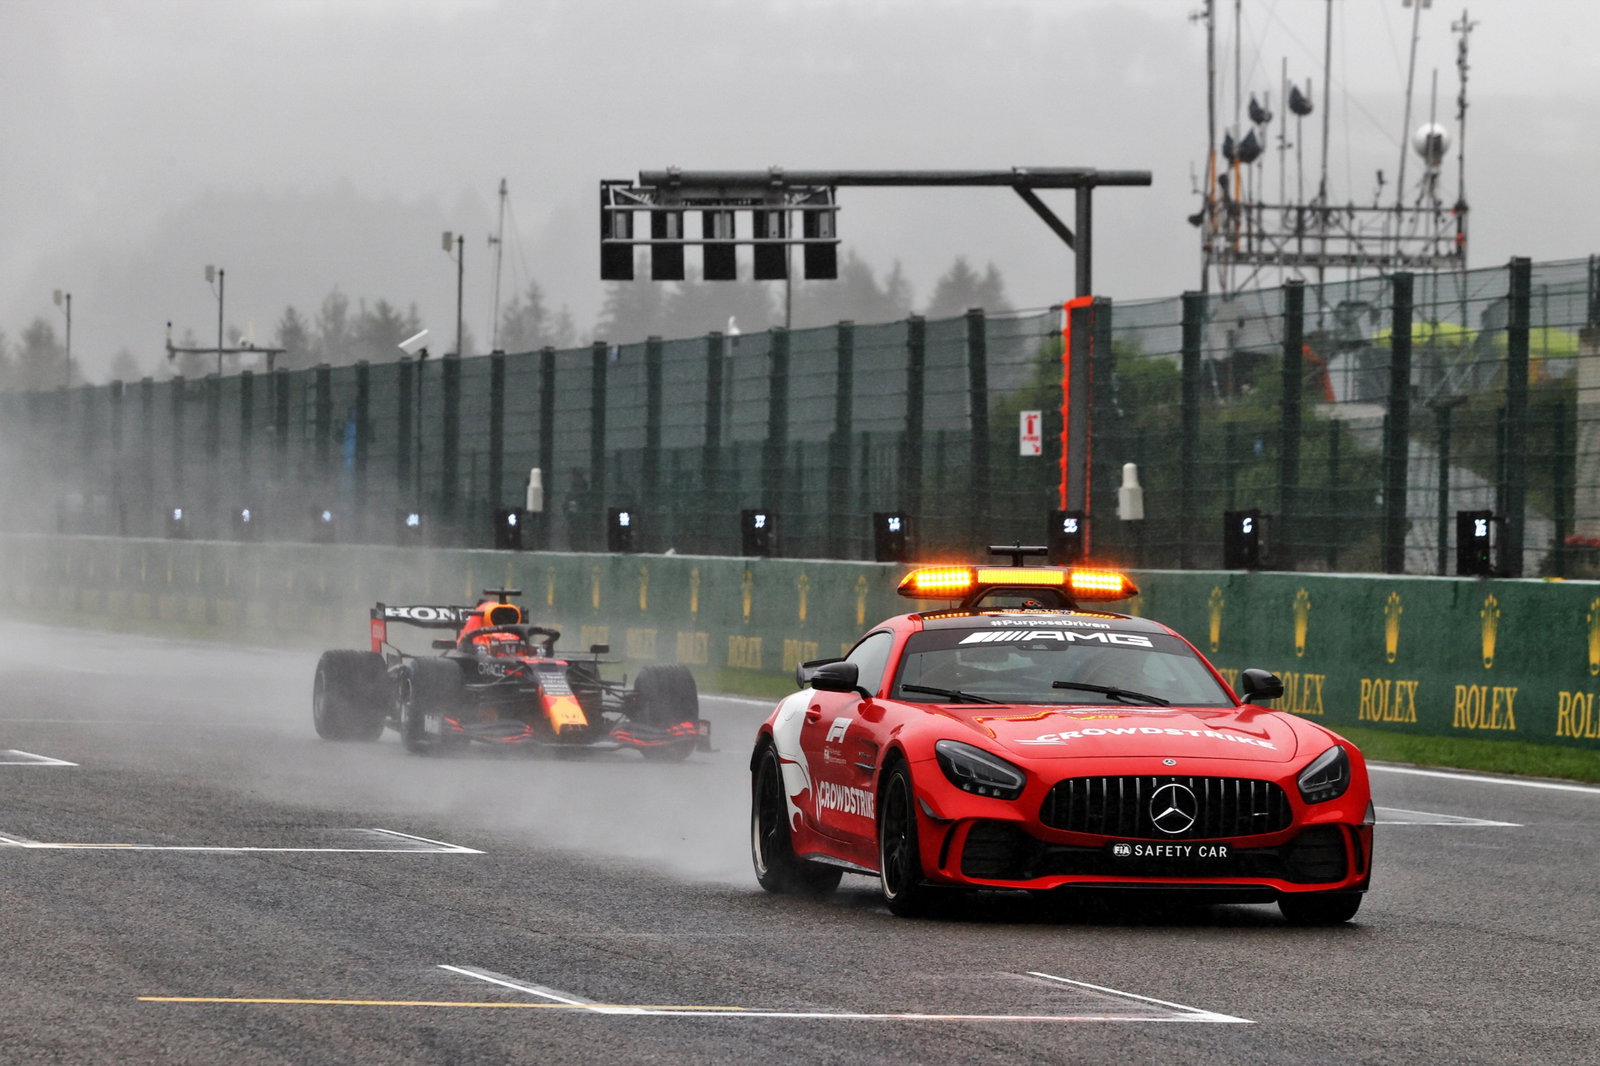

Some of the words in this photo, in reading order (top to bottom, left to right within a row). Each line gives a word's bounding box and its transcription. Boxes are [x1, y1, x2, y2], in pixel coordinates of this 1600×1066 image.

[991, 619, 1111, 629] #PurposeDriven
[1022, 631, 1153, 648] AMG
[1359, 678, 1418, 723] ROLEX
[1453, 685, 1518, 731] ROLEX
[1556, 691, 1600, 738] ROL
[1036, 727, 1278, 750] CROWDSTRIKE
[819, 780, 876, 820] CROWDSTRIKE
[1134, 844, 1192, 857] SAFETY
[1198, 846, 1228, 858] CAR
